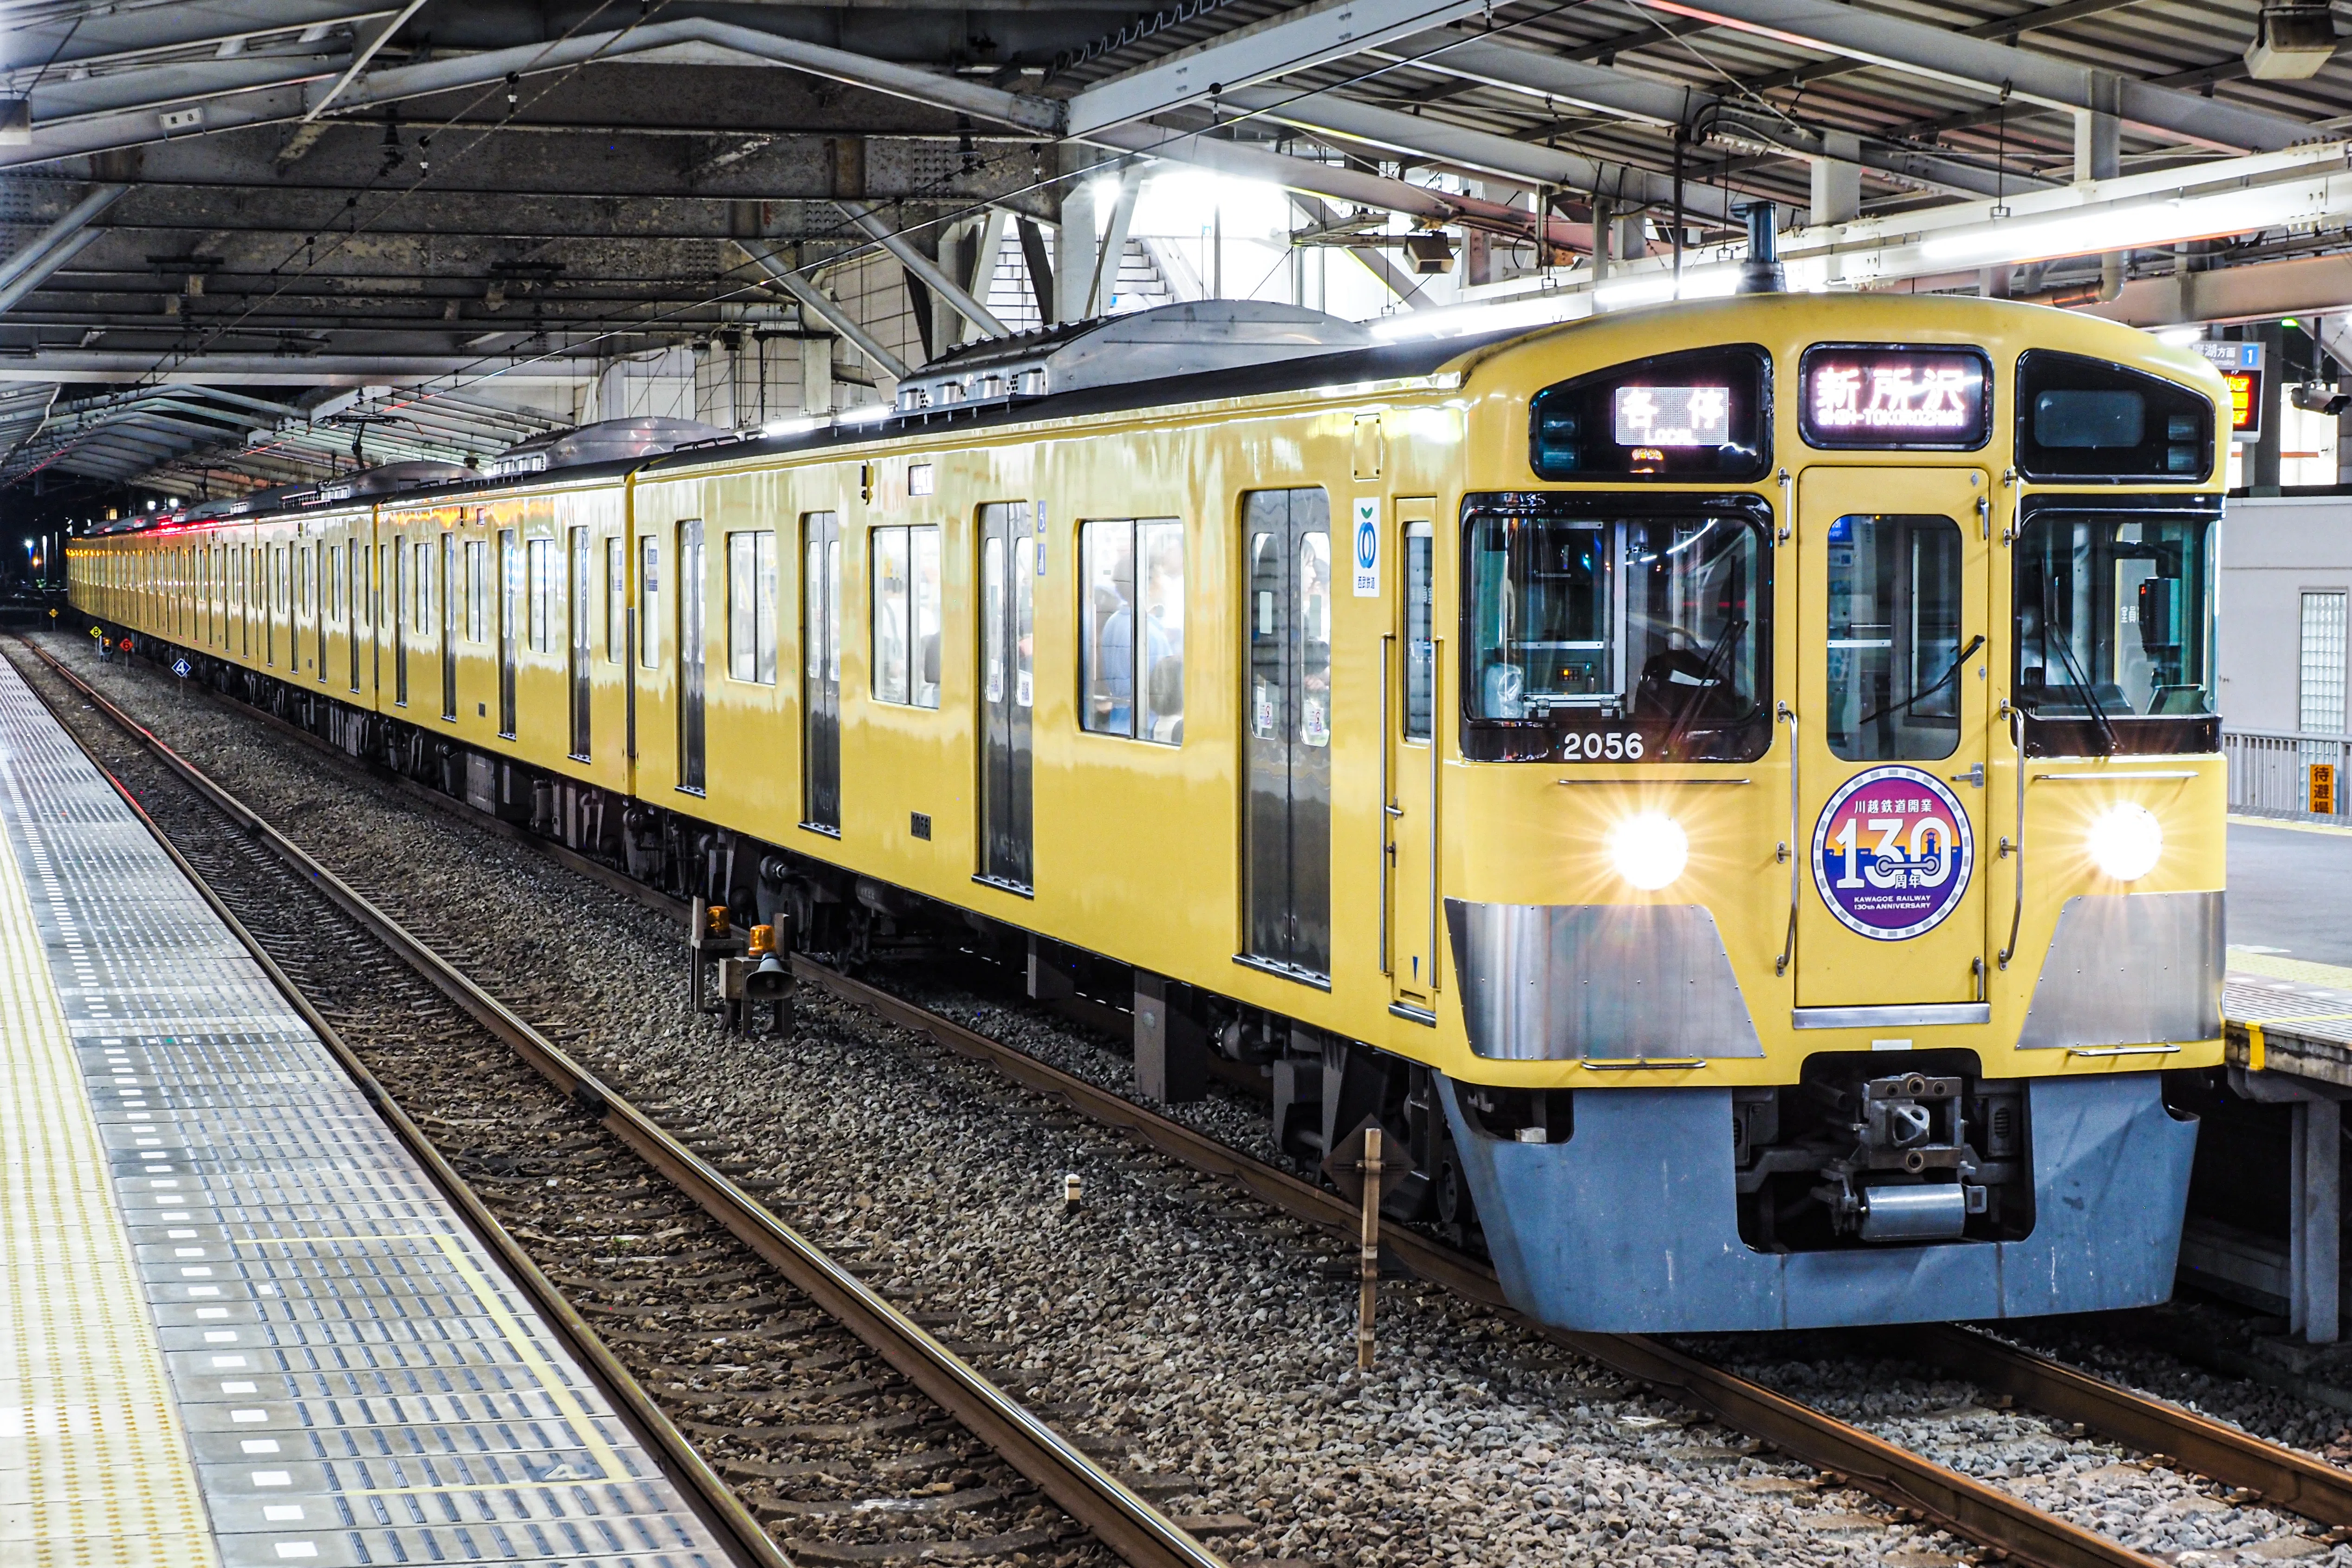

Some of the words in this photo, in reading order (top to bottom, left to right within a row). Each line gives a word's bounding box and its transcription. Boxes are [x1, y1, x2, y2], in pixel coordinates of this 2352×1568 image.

[2247, 349, 2253, 364] 1
[1816, 367, 1965, 410] 新所沢
[123, 641, 130, 649] 6
[176, 662, 185, 674] 4
[1563, 732, 1644, 760] 2056
[1854, 799, 1933, 814] 川越鉄道開業
[1835, 817, 1952, 888] 130
[1895, 874, 1921, 889] 周年
